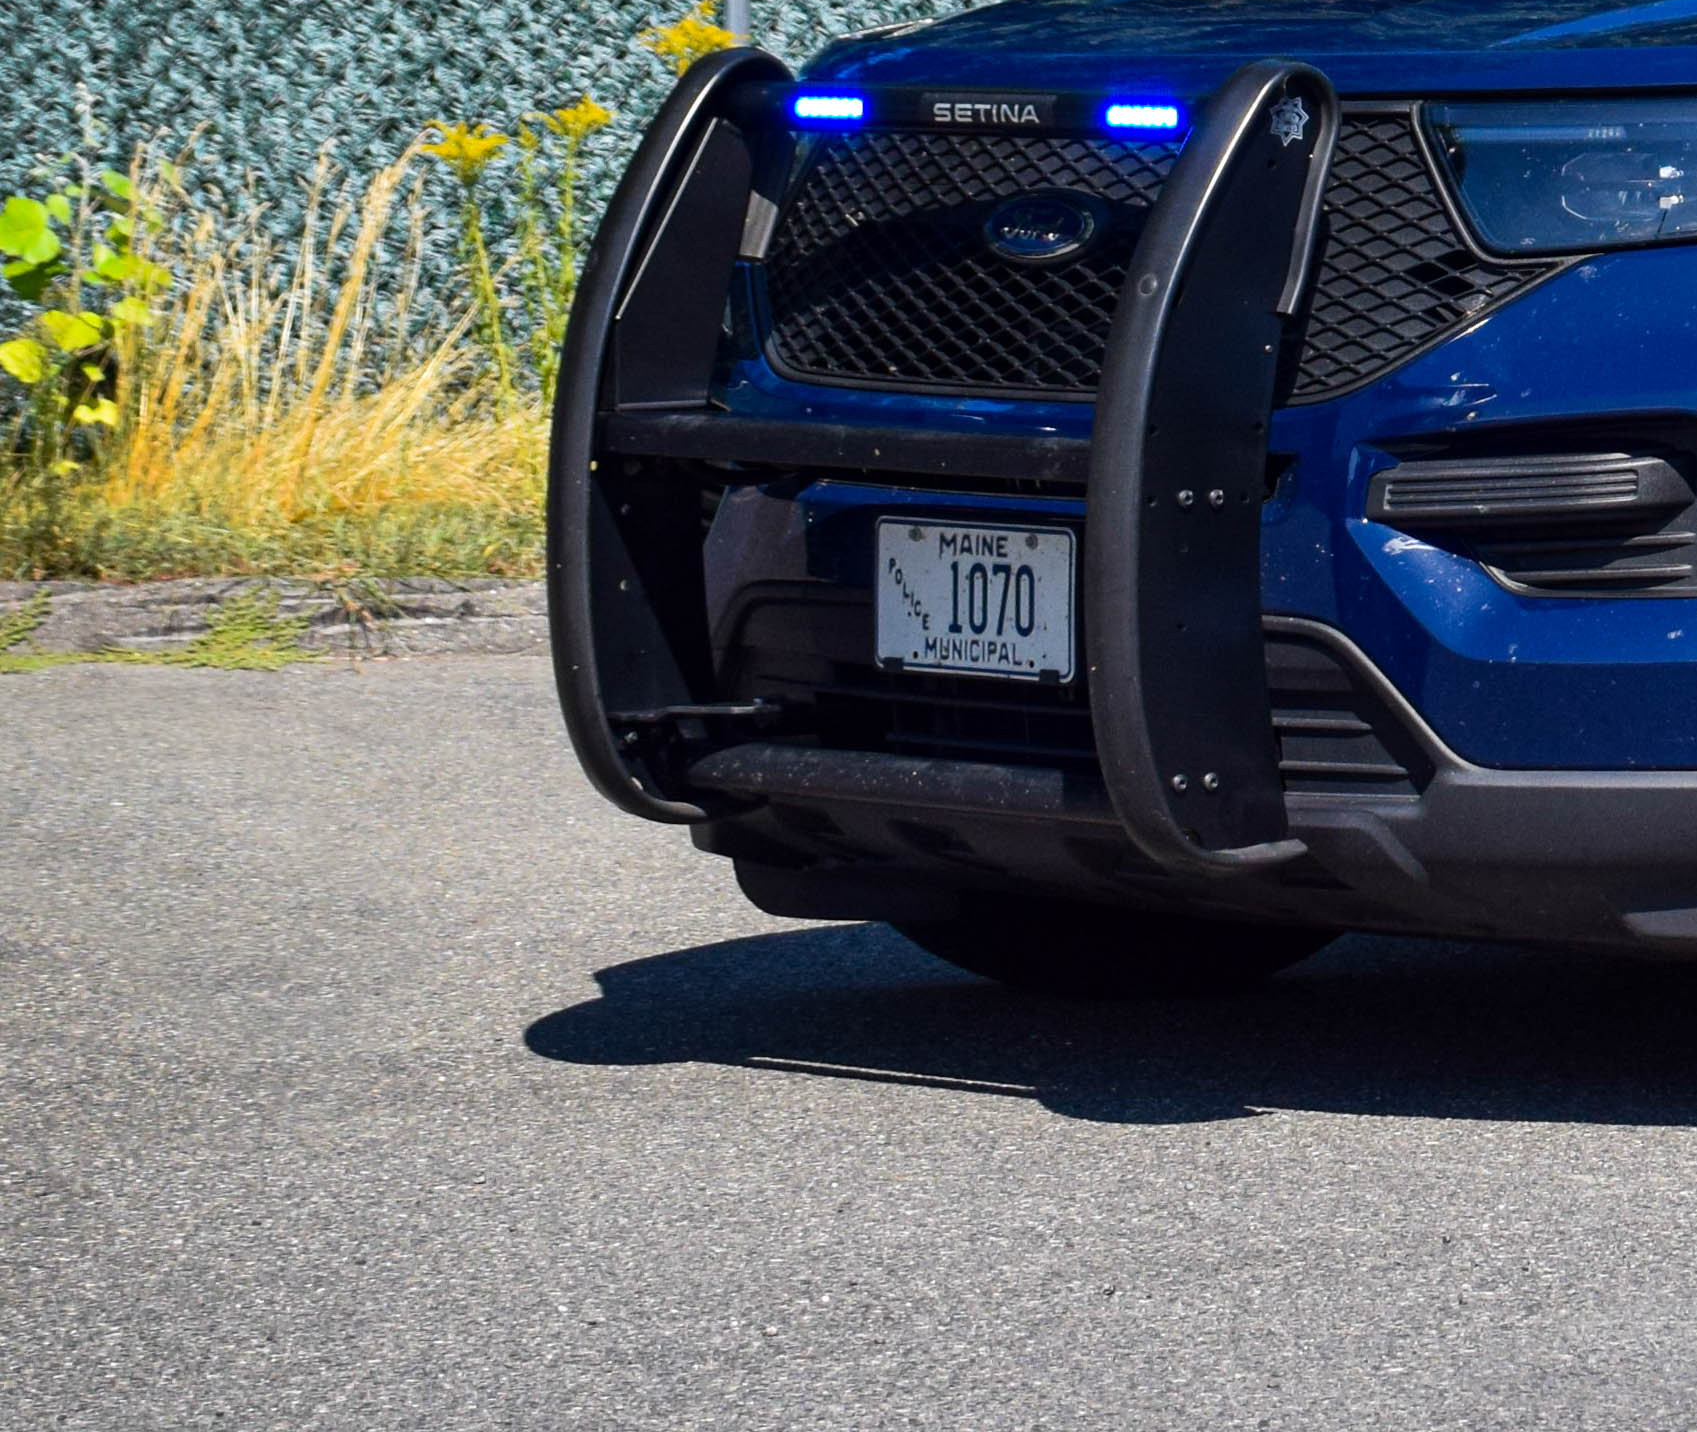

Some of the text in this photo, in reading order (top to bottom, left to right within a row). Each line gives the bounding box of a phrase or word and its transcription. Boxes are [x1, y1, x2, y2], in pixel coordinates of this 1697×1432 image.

[933, 102, 1040, 124] SETINA
[938, 532, 1009, 559] MAINE
[888, 557, 931, 631] POLICE
[948, 560, 1035, 638] 1070
[924, 636, 1023, 667] MUNICIPAL
